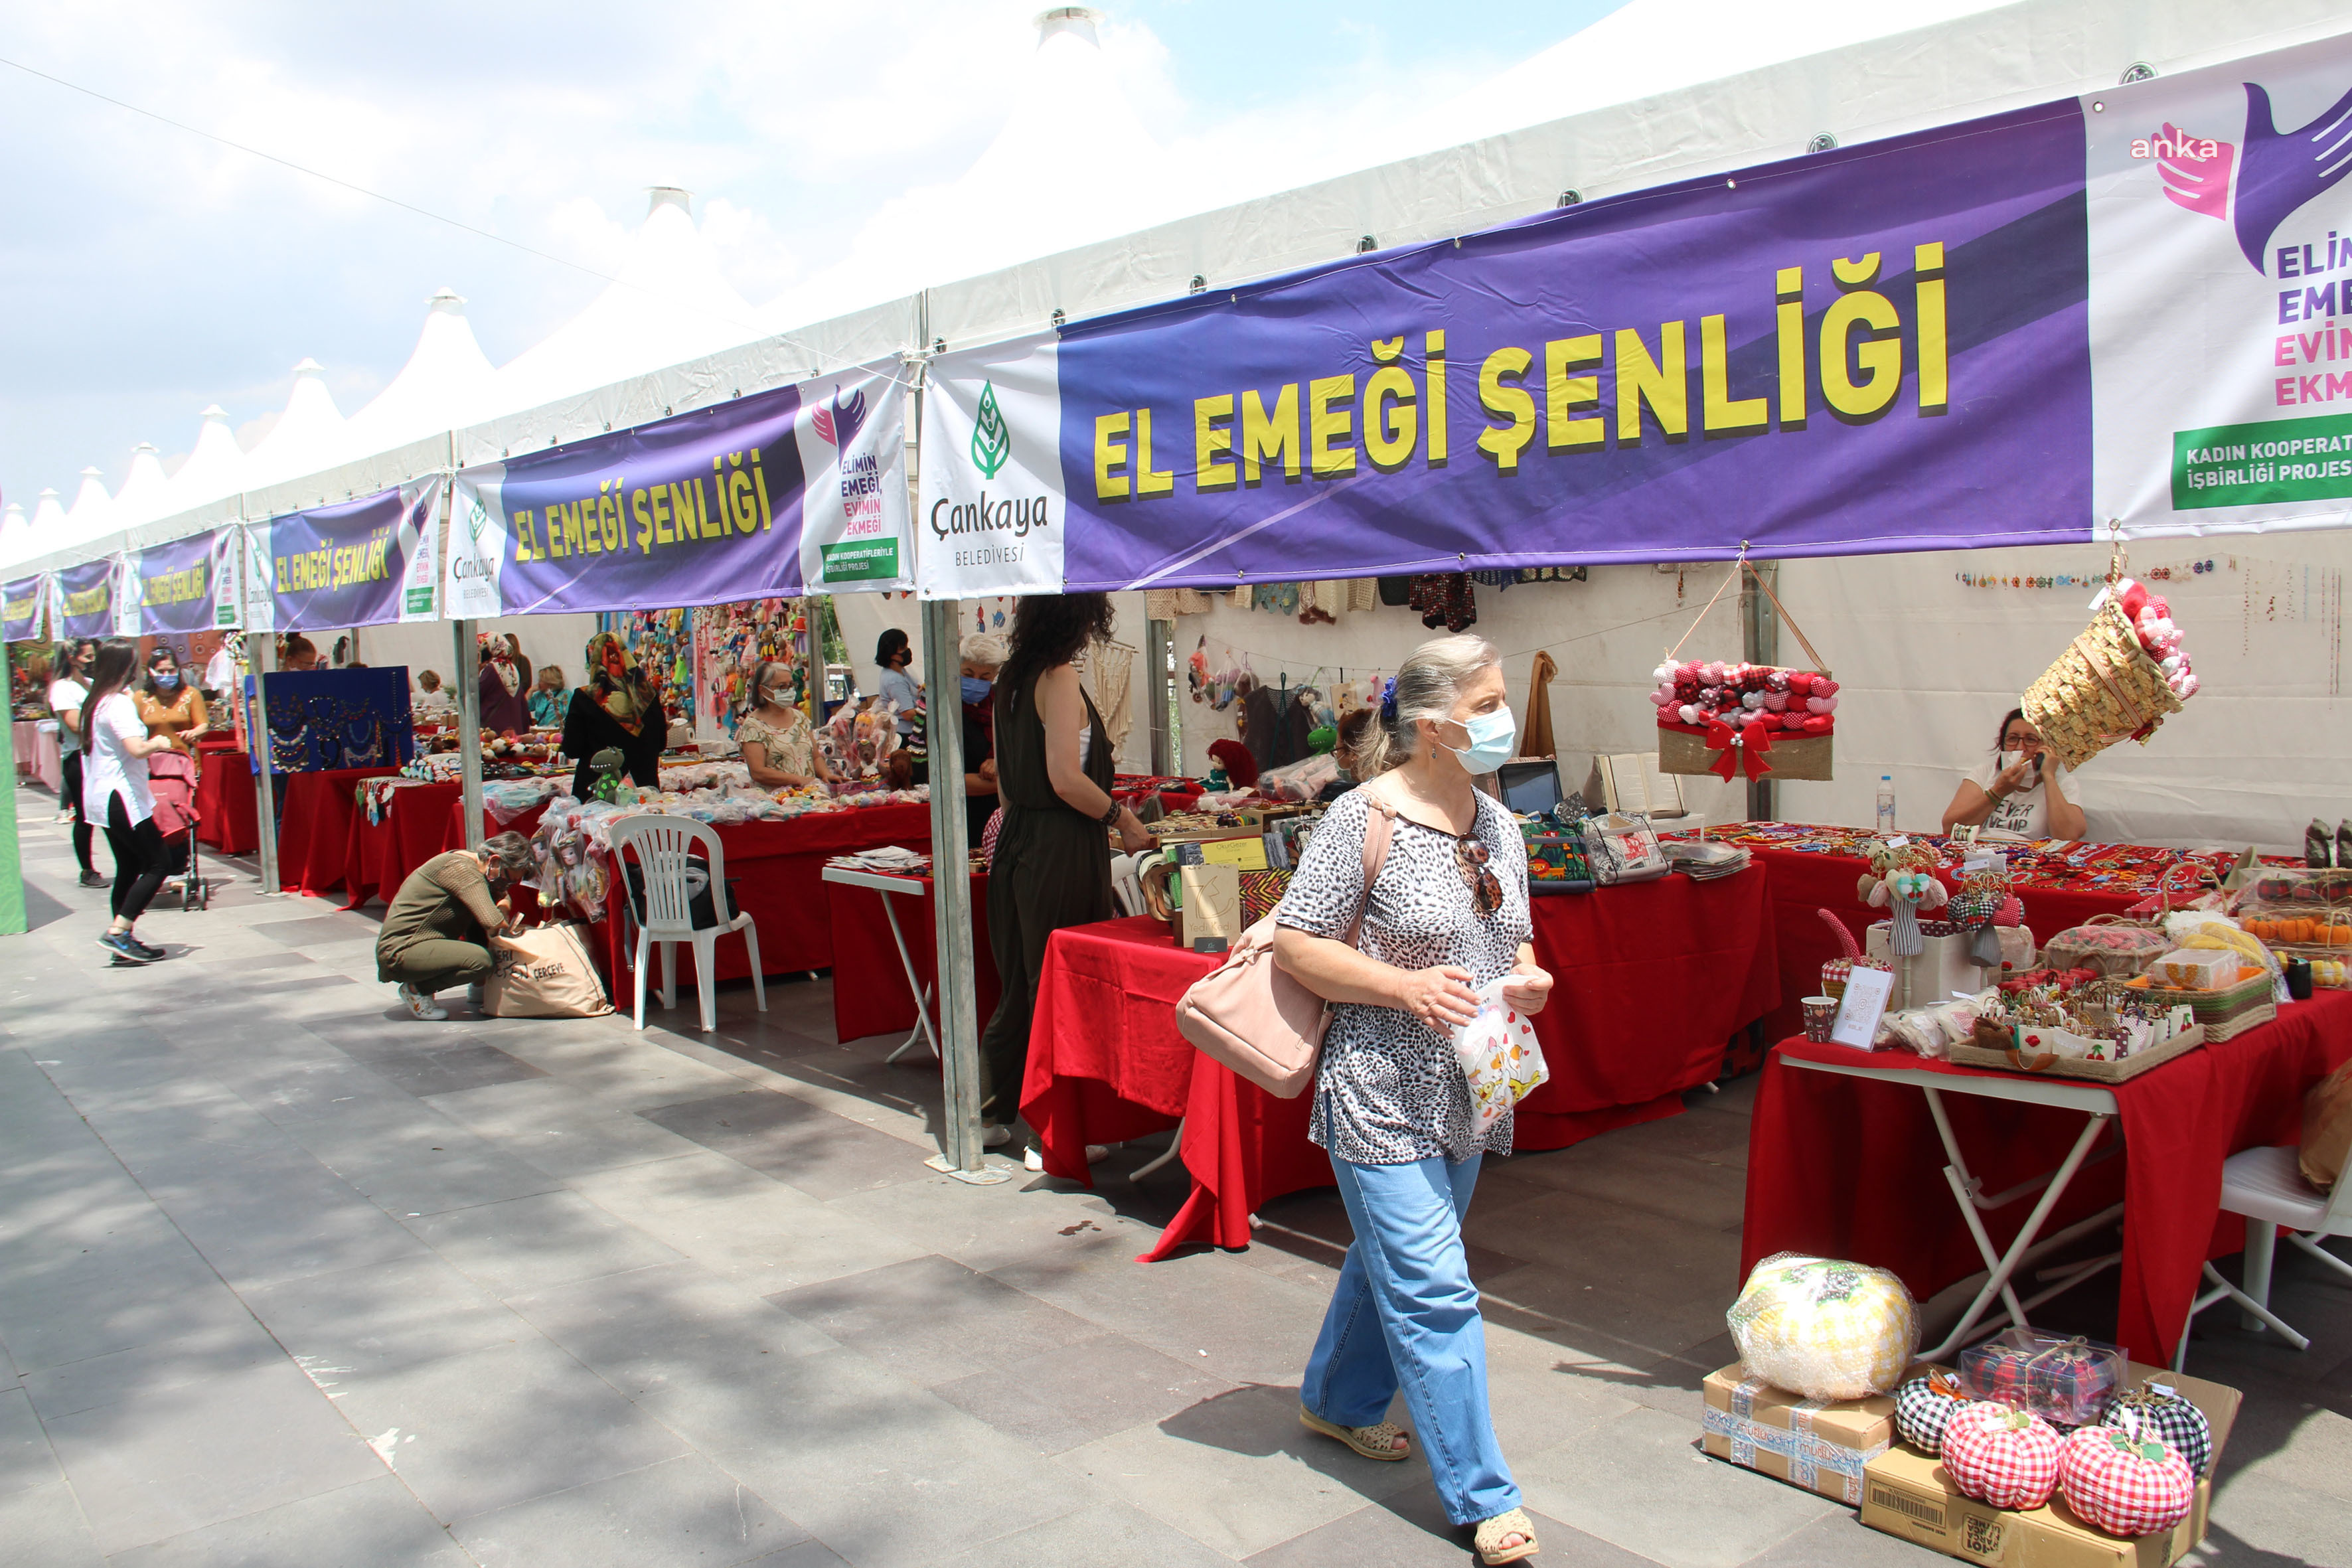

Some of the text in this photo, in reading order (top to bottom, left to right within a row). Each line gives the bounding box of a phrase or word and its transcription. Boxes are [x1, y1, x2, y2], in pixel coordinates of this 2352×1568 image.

[1095, 240, 1950, 499] EL EMEĞİ ŞENLİĞİ
[2187, 435, 2352, 465] KADIN KOOPERAT
[842, 452, 878, 475] ELİMİN
[2187, 459, 2352, 489] İŞBİRLİĞİ PROJES
[514, 448, 771, 562] EL EMEĞİ ŞENLİĞİ
[843, 496, 881, 517] EVİMİN
[931, 491, 1048, 542] Çankaya
[847, 515, 882, 536] EKMEĞİ
[275, 525, 391, 594] EL EMEĞİ ŞENLİĞİ
[840, 546, 894, 562] KOOPERATİFLERİYLE
[955, 542, 1024, 566] BELEDİYESİ
[453, 553, 495, 582] Çankaya
[1994, 799, 2034, 817] EVER
[2007, 819, 2028, 832] UP
[533, 962, 566, 982] ÇERÇEVE
